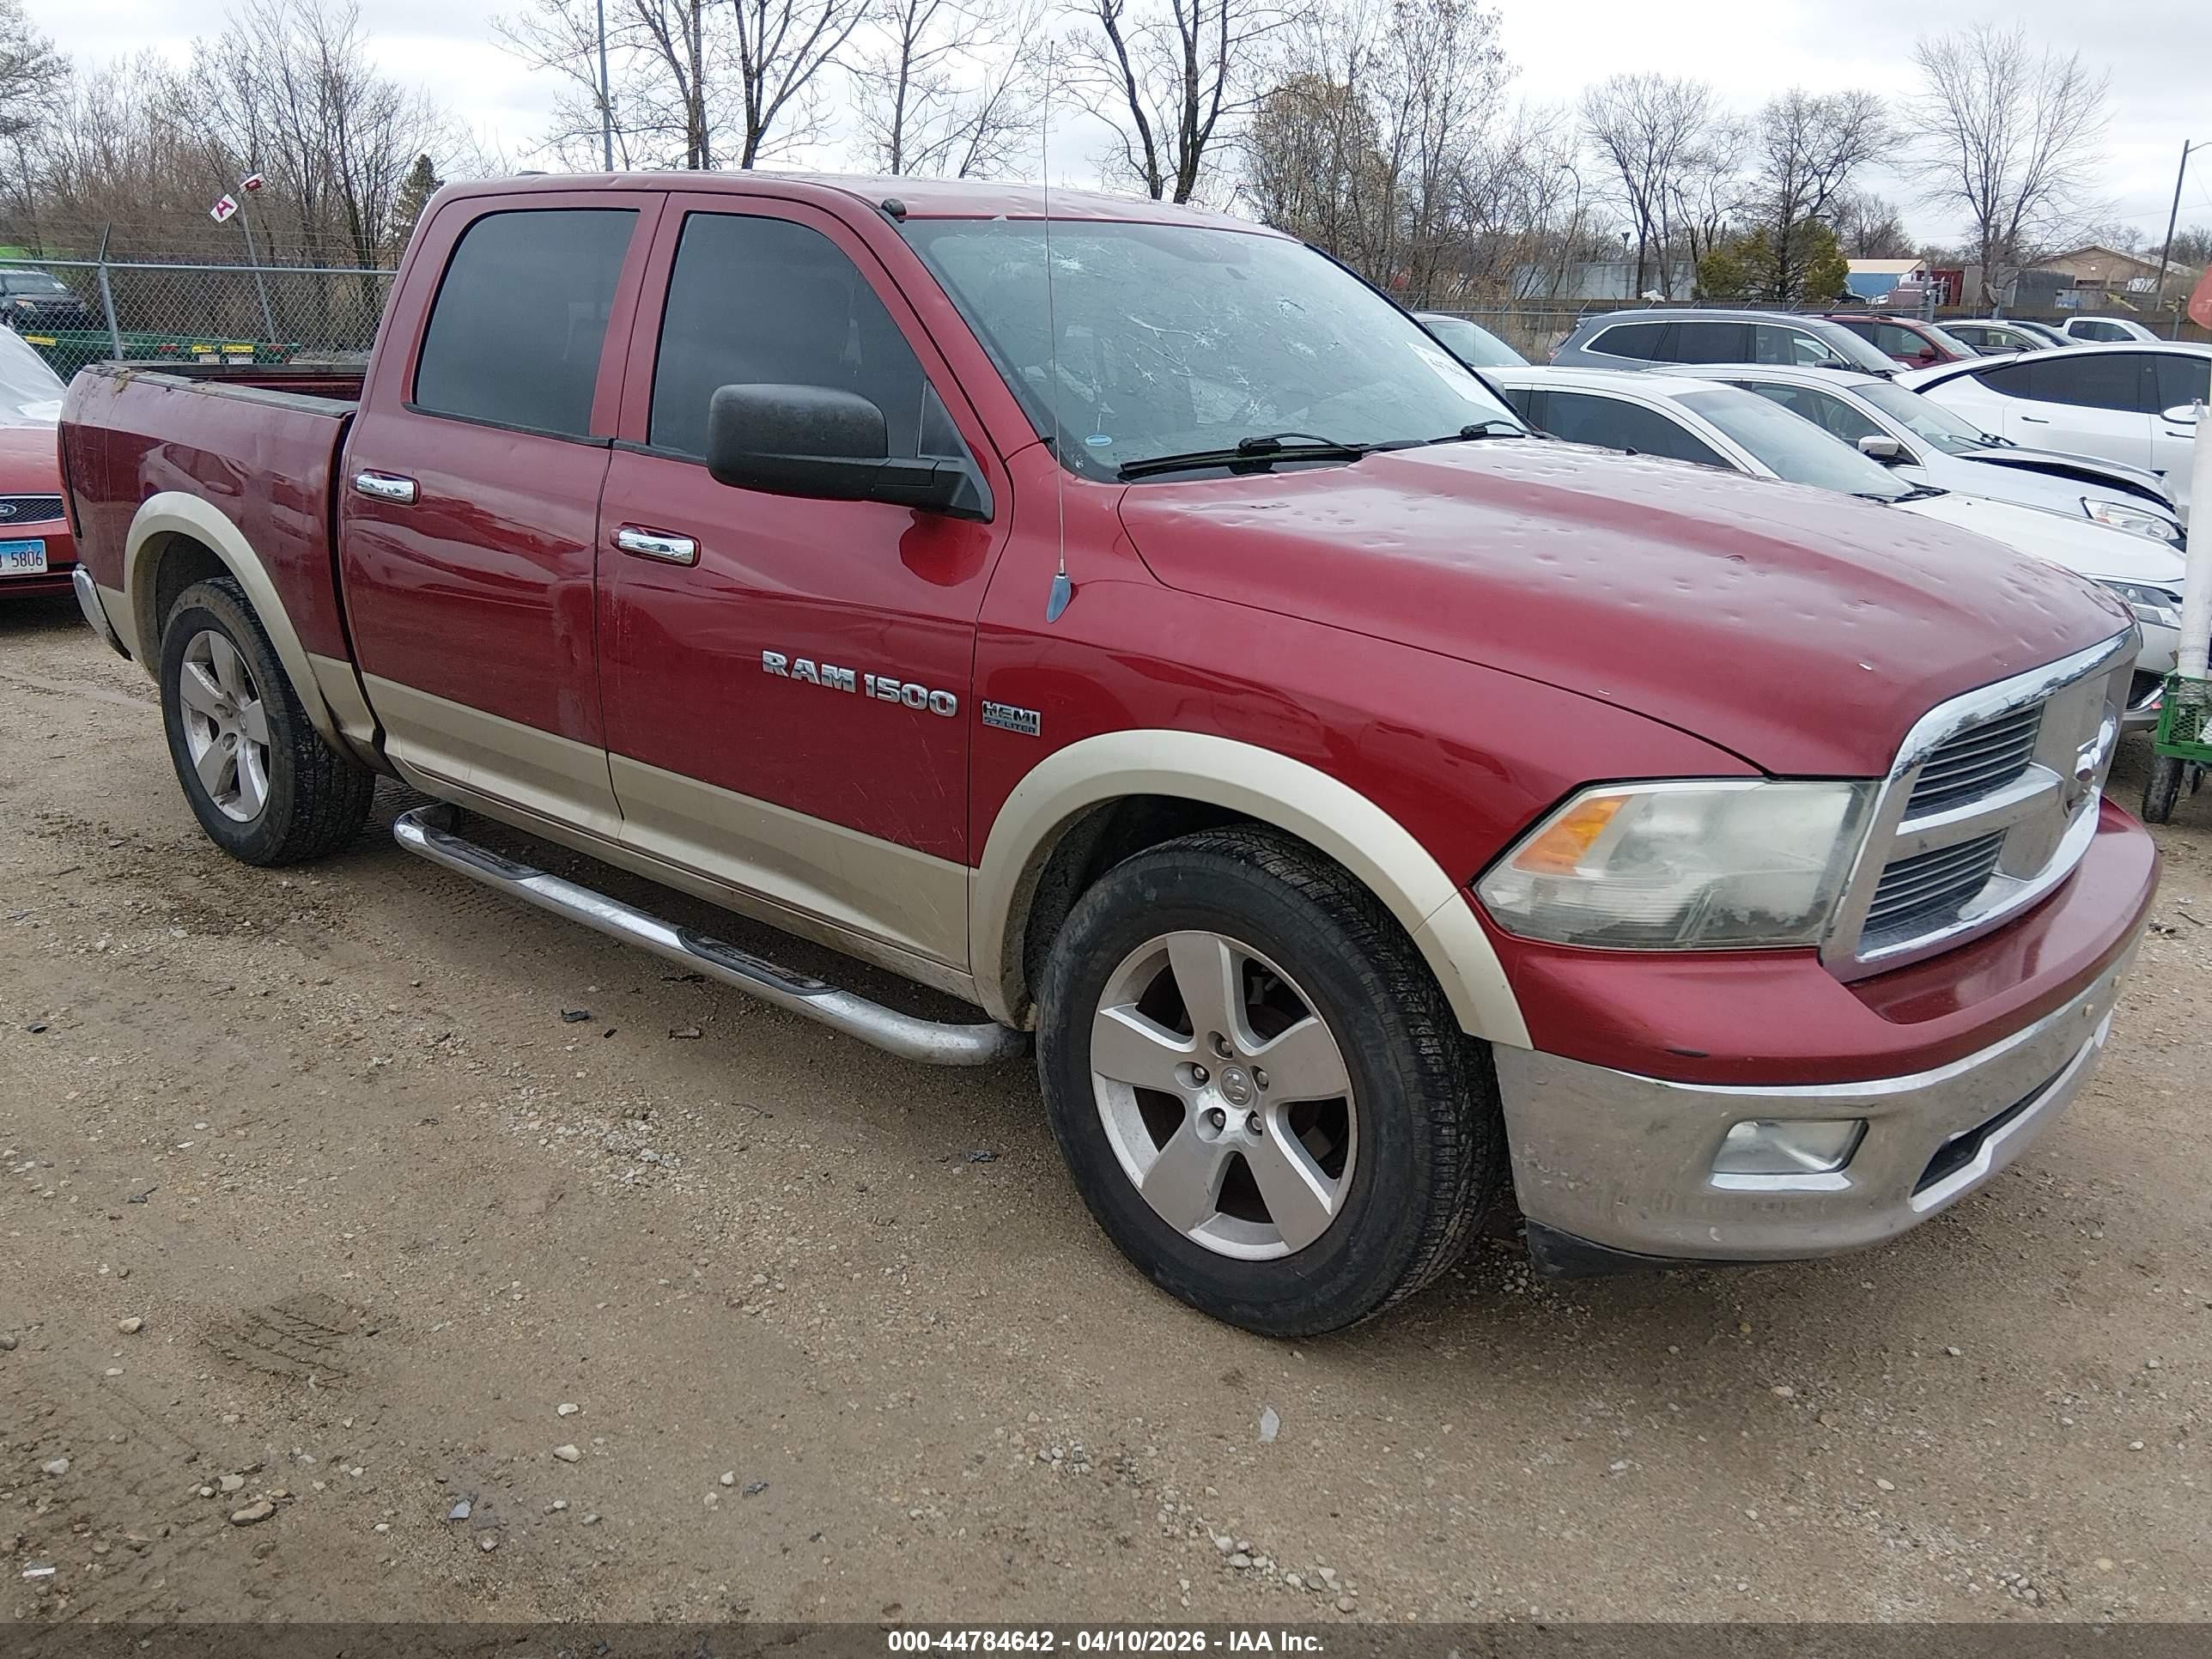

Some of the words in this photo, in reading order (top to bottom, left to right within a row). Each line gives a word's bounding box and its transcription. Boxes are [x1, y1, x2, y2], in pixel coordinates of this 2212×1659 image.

[10, 550, 43, 567] 5806
[762, 650, 857, 693] RAM
[864, 673, 958, 718] 1500
[982, 702, 1037, 725] HEMI
[1004, 721, 1036, 734] LITER
